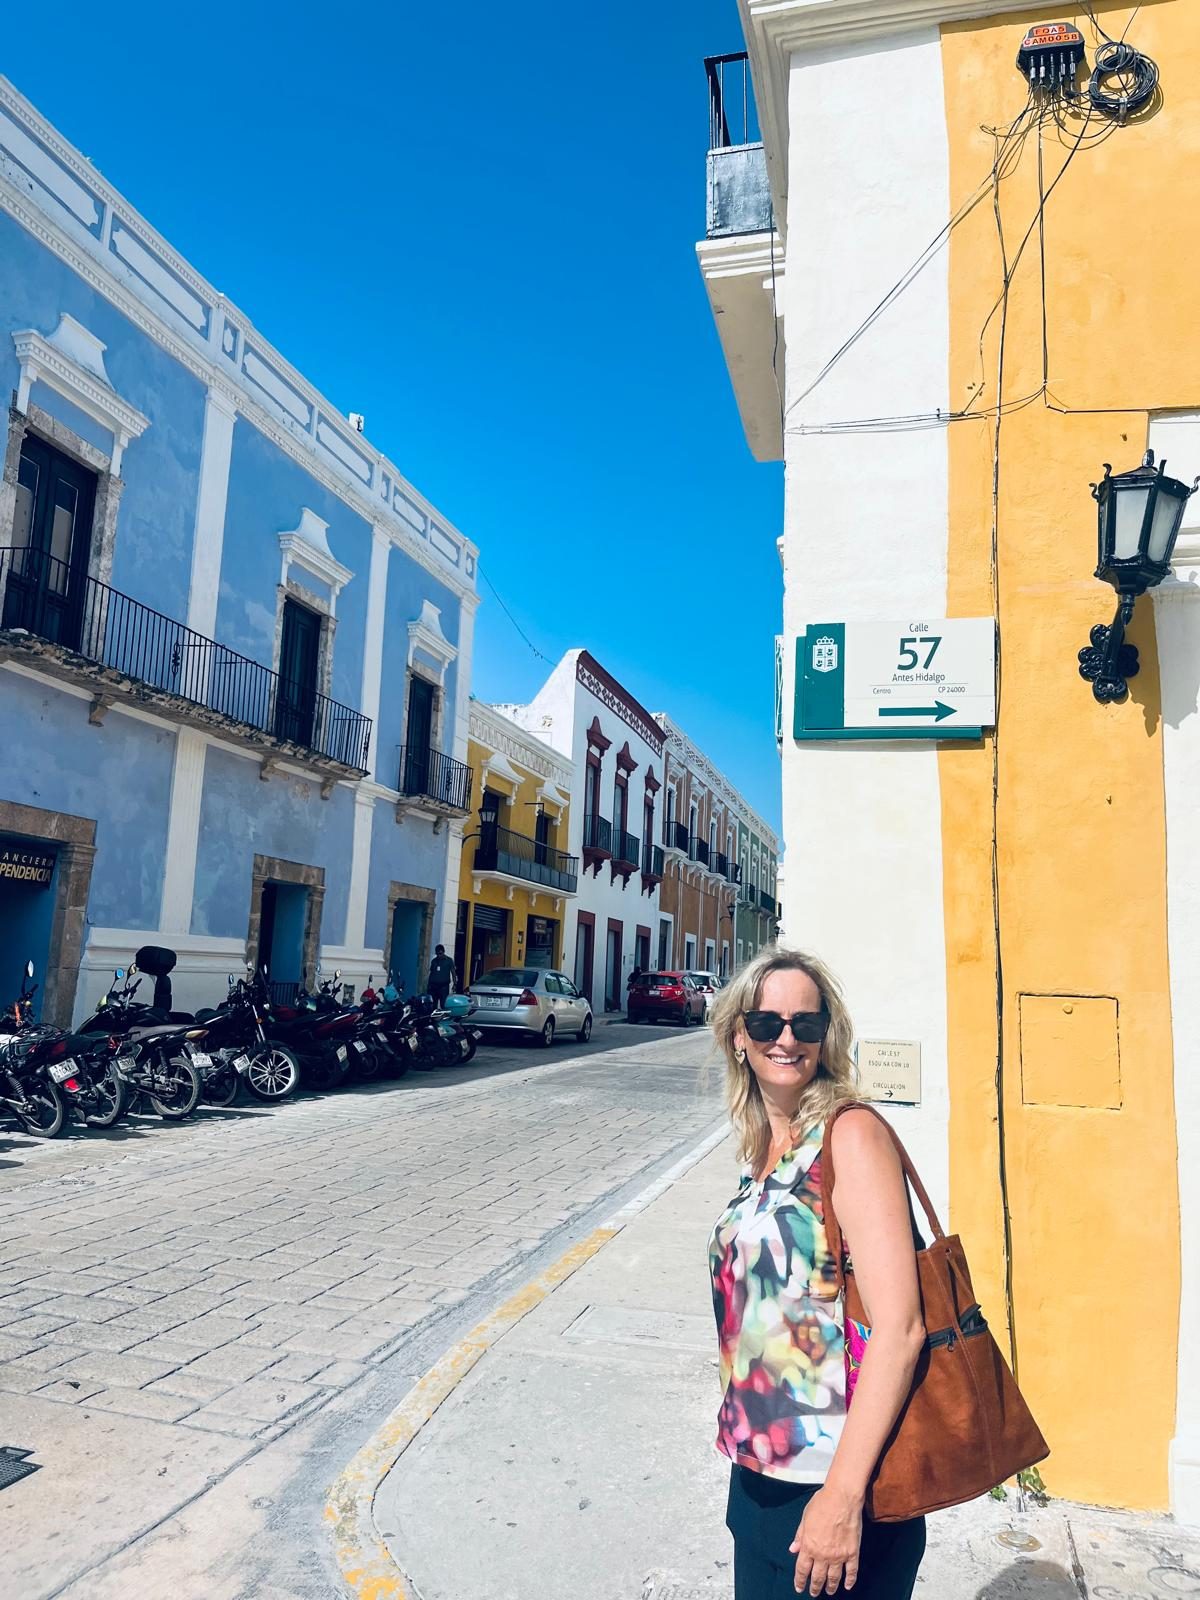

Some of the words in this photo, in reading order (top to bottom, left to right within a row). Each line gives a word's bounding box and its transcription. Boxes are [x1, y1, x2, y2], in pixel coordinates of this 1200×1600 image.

[909, 623, 929, 633] Calle
[897, 636, 942, 671] 57
[892, 673, 914, 682] Antes
[915, 672, 946, 684] Hidalgo
[872, 687, 892, 695] Centro
[0, 862, 52, 882] PENDENCIA
